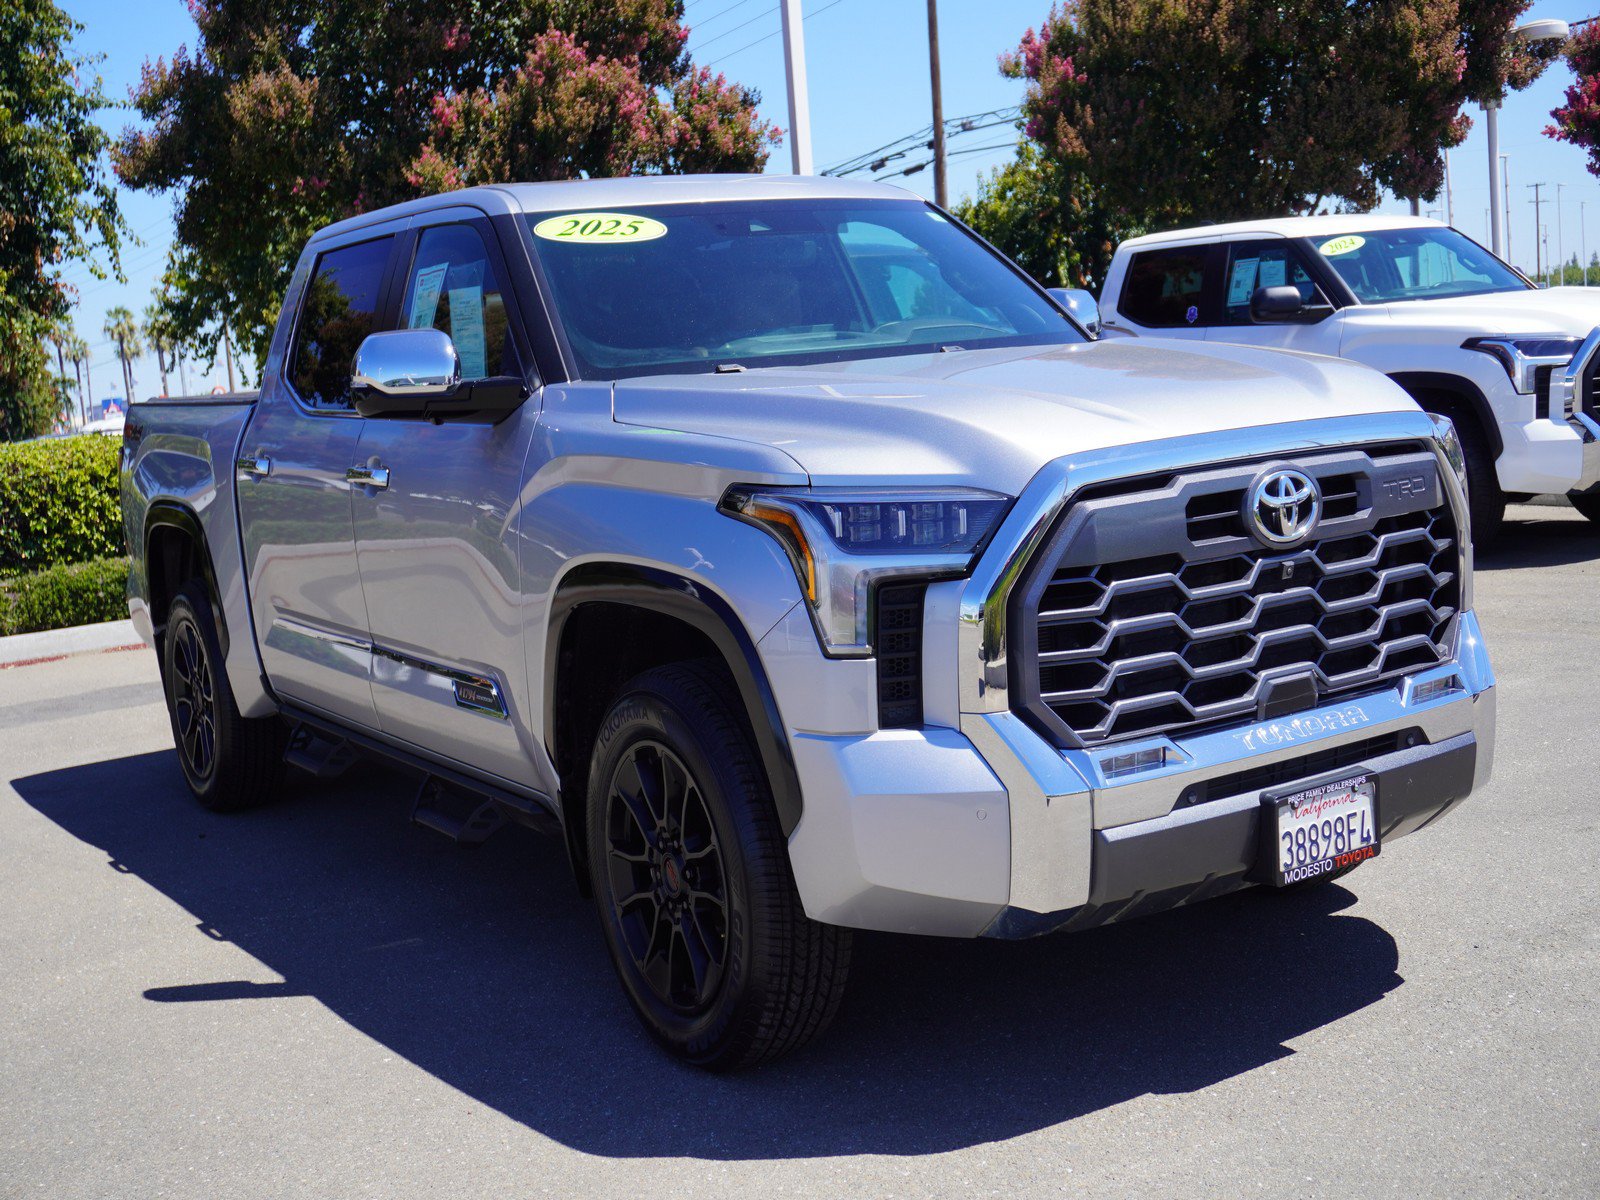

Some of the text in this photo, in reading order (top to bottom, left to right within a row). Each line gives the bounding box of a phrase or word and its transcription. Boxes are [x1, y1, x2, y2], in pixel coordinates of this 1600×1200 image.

[555, 218, 646, 237] 2025
[1382, 475, 1426, 500] TRD
[598, 703, 650, 749] YOKOHAMA
[1232, 706, 1369, 750] TUNDRA
[1295, 791, 1358, 820] California
[1306, 786, 1327, 801] FAMILY
[1326, 776, 1367, 794] DEALERSHIPS
[1281, 809, 1372, 870] 38898F4
[1284, 845, 1375, 885] MODESTO TOYOTA
